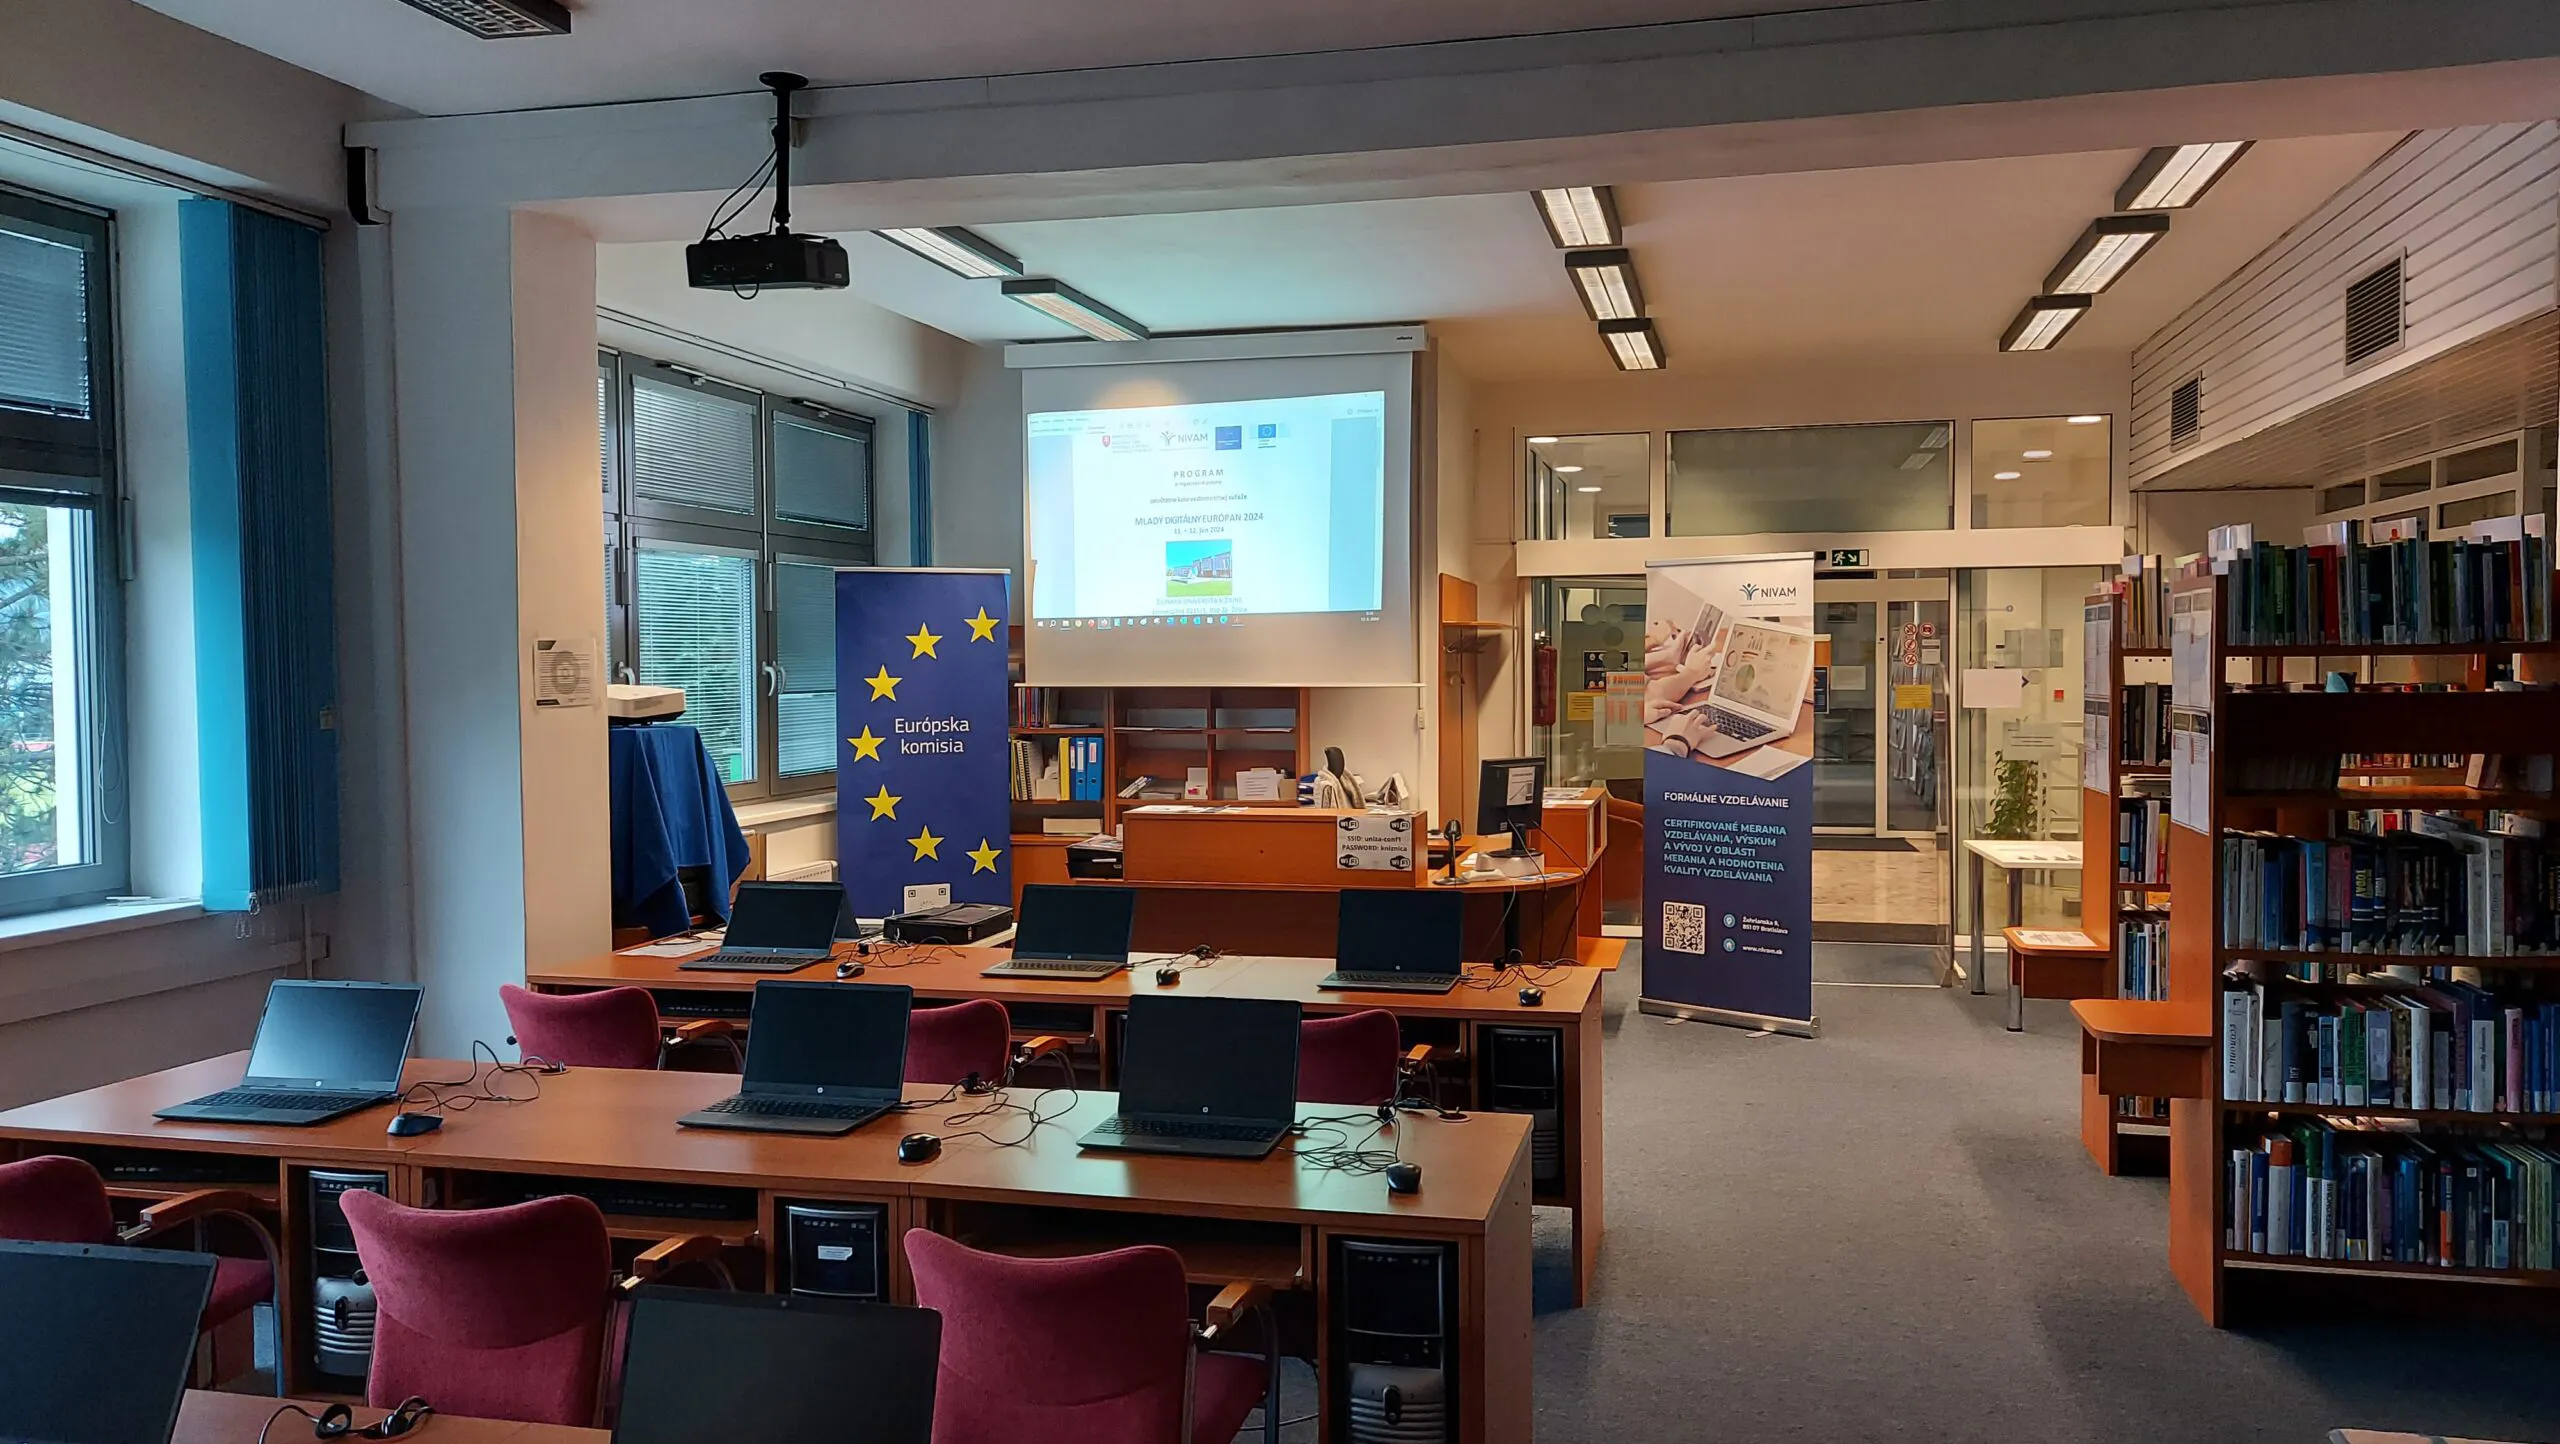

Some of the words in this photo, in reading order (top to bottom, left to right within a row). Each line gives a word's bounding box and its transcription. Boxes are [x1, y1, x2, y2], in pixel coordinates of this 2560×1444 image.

[1178, 433, 1208, 443] NIVAM
[1135, 515, 1163, 526] MLADÝ
[1165, 515, 1201, 525] DIGITÁLNY
[1202, 512, 1241, 523] EURÓPAN
[1243, 513, 1264, 521] 2024
[1761, 587, 1797, 598] NIVAM
[895, 716, 969, 736] Európska
[901, 739, 964, 754] komisia
[1664, 792, 1717, 804] FORMÁLNE
[1719, 795, 1789, 808] VZDELÁVANIE
[1664, 819, 1738, 832] CERTIFIKOVANÉ
[1740, 823, 1787, 835] MERANIA
[1664, 830, 1733, 844] VZDELÁVANIA,
[1735, 834, 1777, 846] VÝSKUM
[1663, 842, 1671, 850] A
[1673, 841, 1702, 853] VÝVOJ
[1704, 845, 1712, 853] V
[1714, 846, 1756, 857] OBLASTI
[1663, 853, 1707, 865] MERANIA
[1708, 857, 1716, 866] A
[1718, 858, 1785, 871] HODNOTENIA
[1664, 865, 1701, 876] KVALITY
[1703, 869, 1773, 883] VZDELÁVANIA
